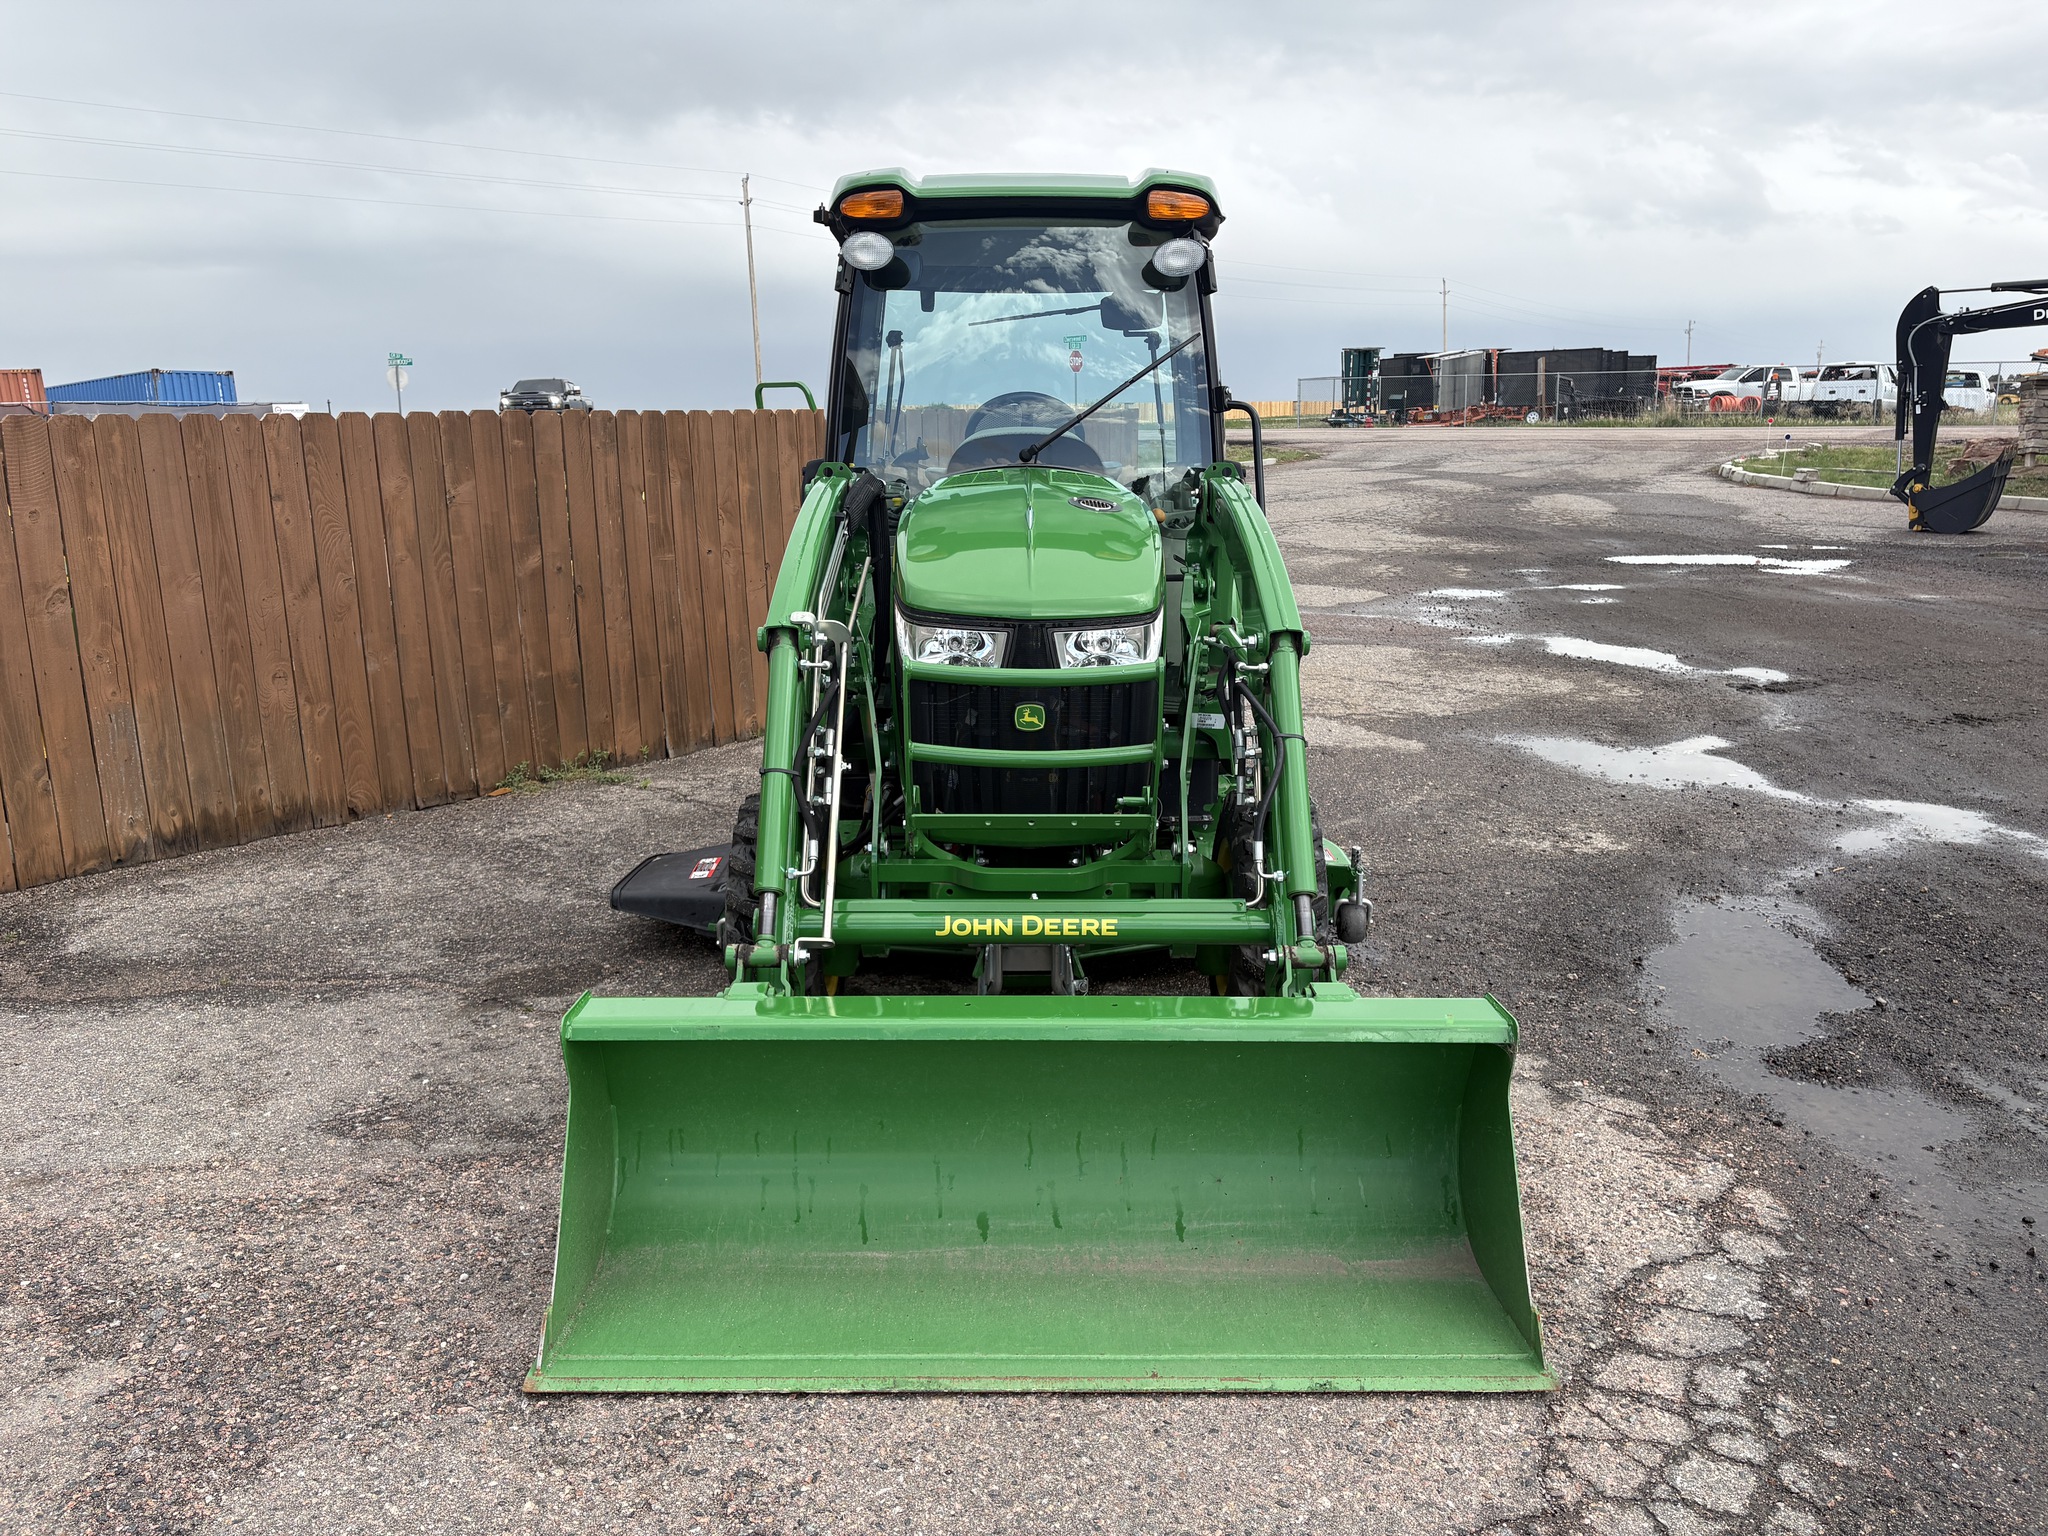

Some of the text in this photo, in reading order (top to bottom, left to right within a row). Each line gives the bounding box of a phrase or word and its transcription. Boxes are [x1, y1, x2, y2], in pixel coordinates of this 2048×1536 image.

[2033, 308, 2048, 321] D
[1070, 357, 1083, 366] STOP
[935, 915, 1118, 937] JOHN DEERE
